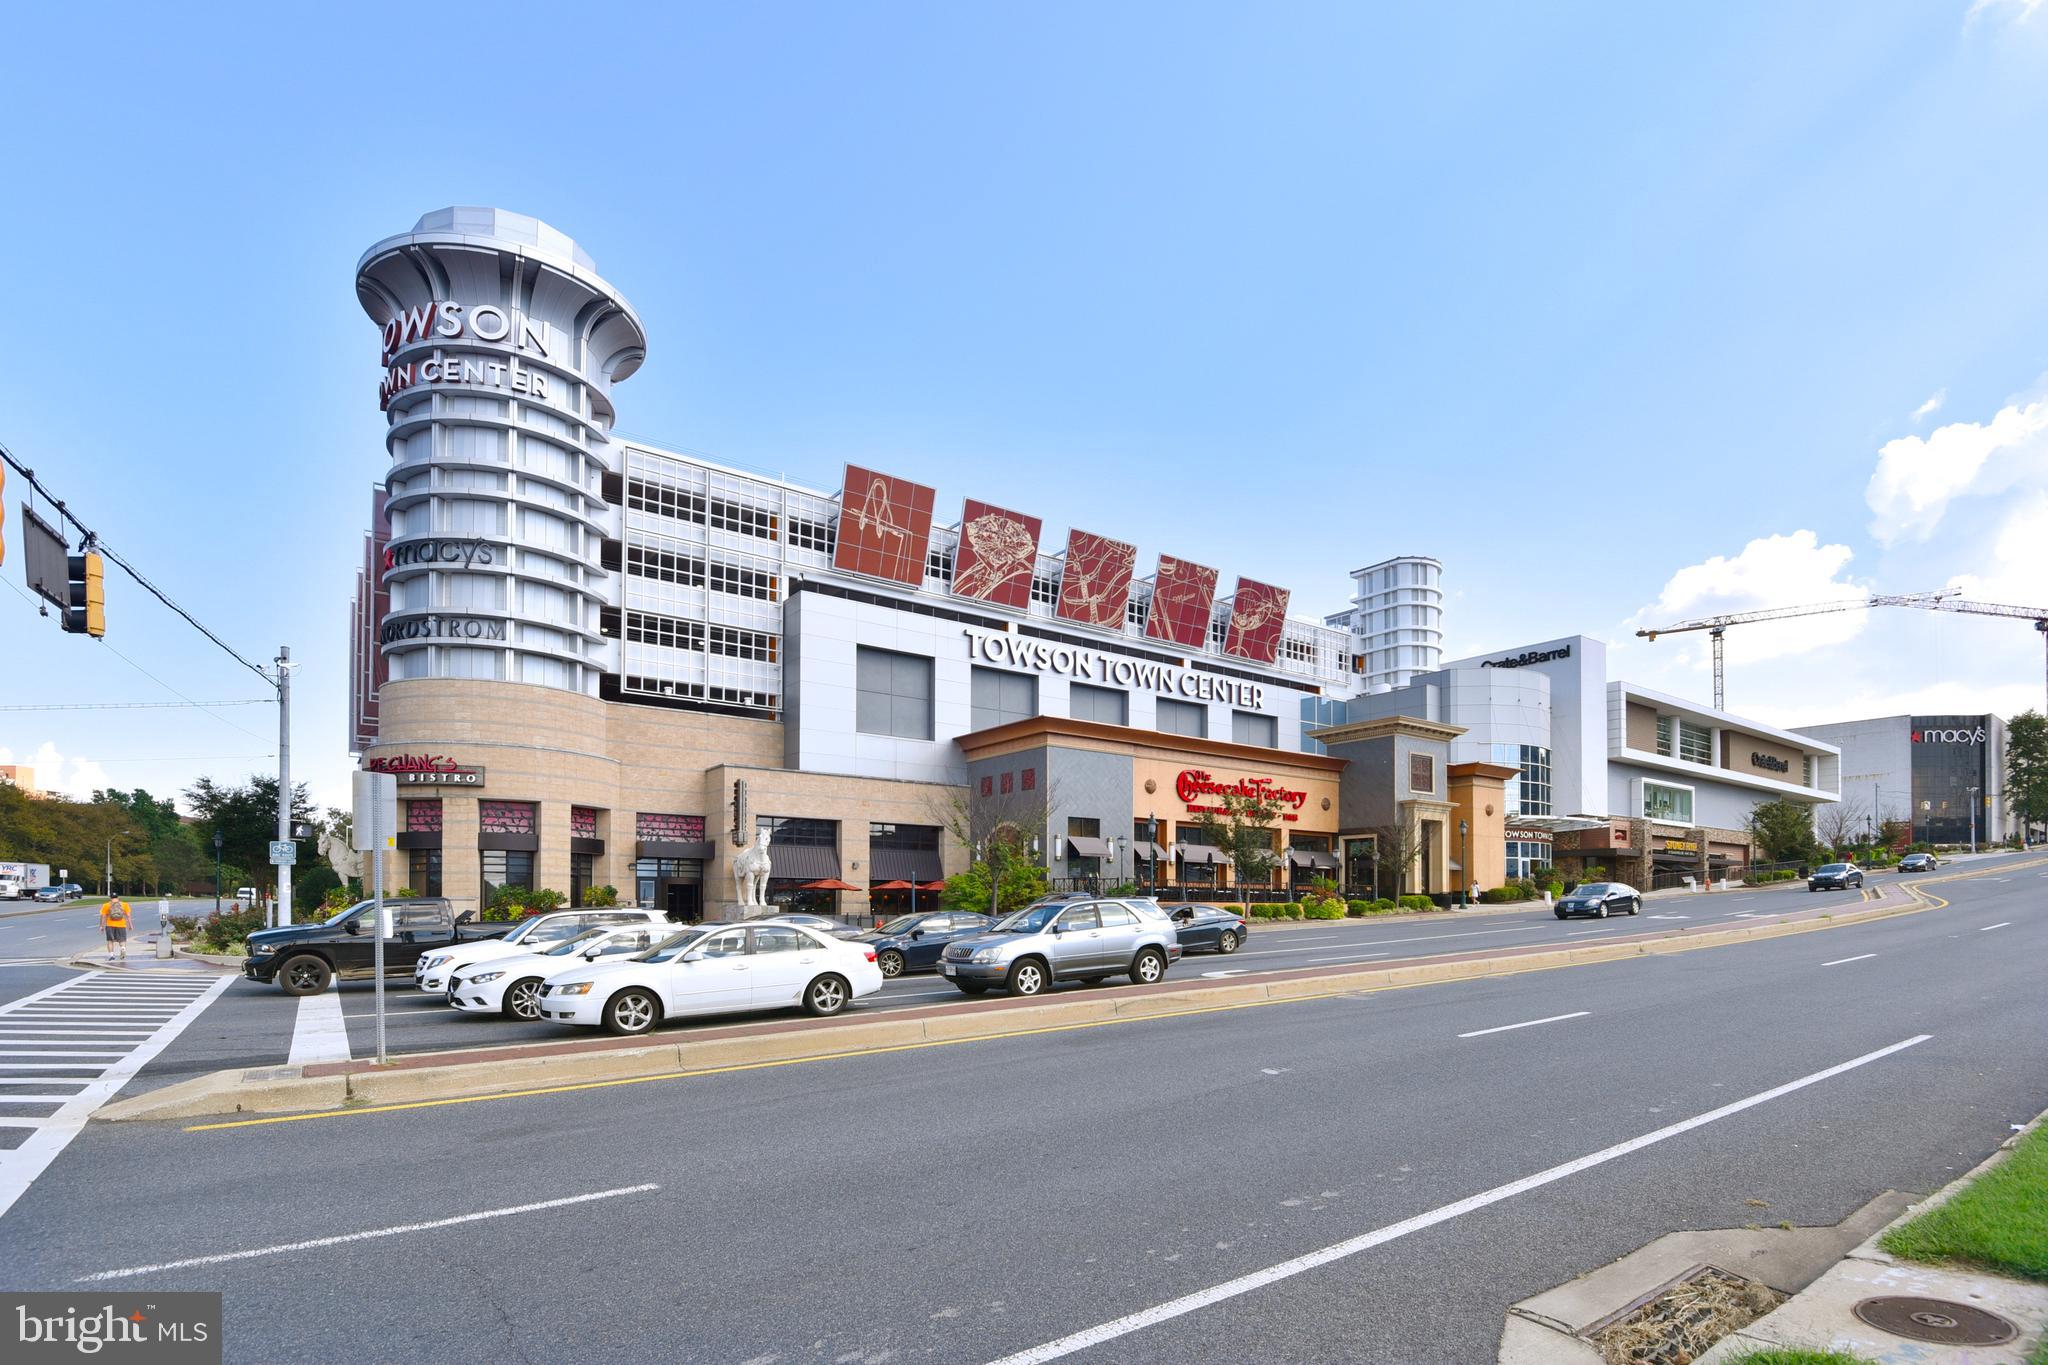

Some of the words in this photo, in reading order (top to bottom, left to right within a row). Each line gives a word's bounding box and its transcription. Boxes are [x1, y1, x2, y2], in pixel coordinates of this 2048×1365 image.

[382, 301, 550, 358] OWSON
[379, 362, 415, 400] OWN
[421, 358, 549, 399] CENTER
[381, 616, 507, 644] NORDSTROM
[965, 629, 1092, 677] TOWSON
[1100, 655, 1173, 693] TOWN
[1181, 671, 1264, 709] CENTER
[1924, 725, 1986, 746] macy's
[408, 773, 476, 783] BISTRO
[1177, 769, 1257, 802] Cheesecake
[1249, 778, 1307, 809] Factory
[1504, 831, 1533, 839] OWSON
